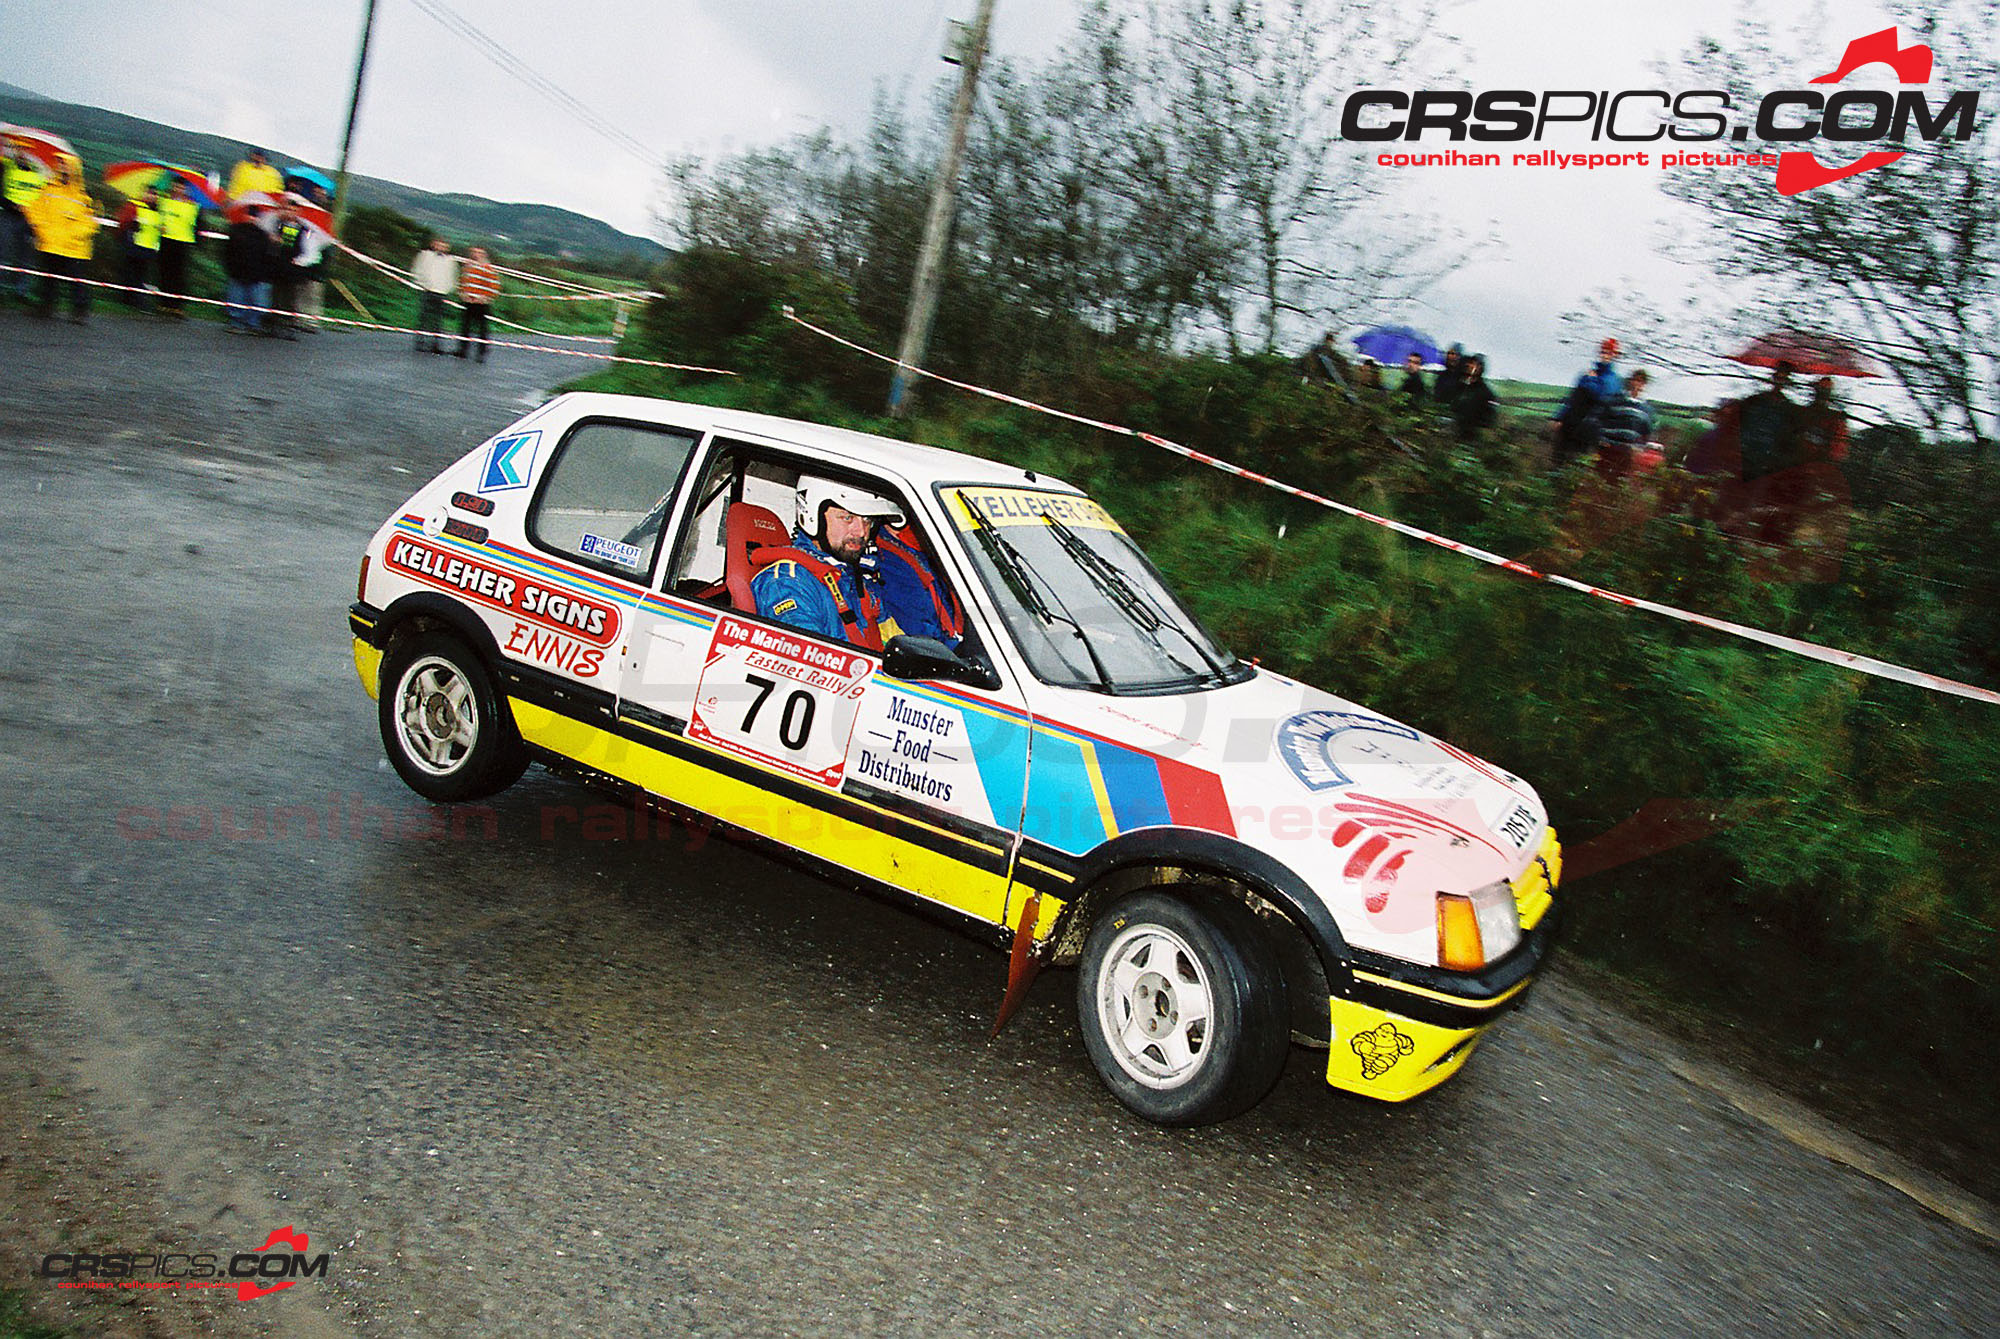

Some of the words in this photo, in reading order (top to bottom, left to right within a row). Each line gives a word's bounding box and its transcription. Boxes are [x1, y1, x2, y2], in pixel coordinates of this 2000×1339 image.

[595, 538, 640, 557] PEUGEOT
[392, 539, 518, 607] KELLEHER
[520, 584, 608, 635] SIGNS
[503, 621, 606, 678] ENNIS
[722, 620, 749, 641] The
[750, 629, 801, 658] Marine
[802, 644, 848, 673] Hotel
[745, 650, 805, 678] Fastnet
[741, 672, 816, 751] 70
[886, 695, 955, 738] Munster
[858, 749, 954, 803] Distributors
